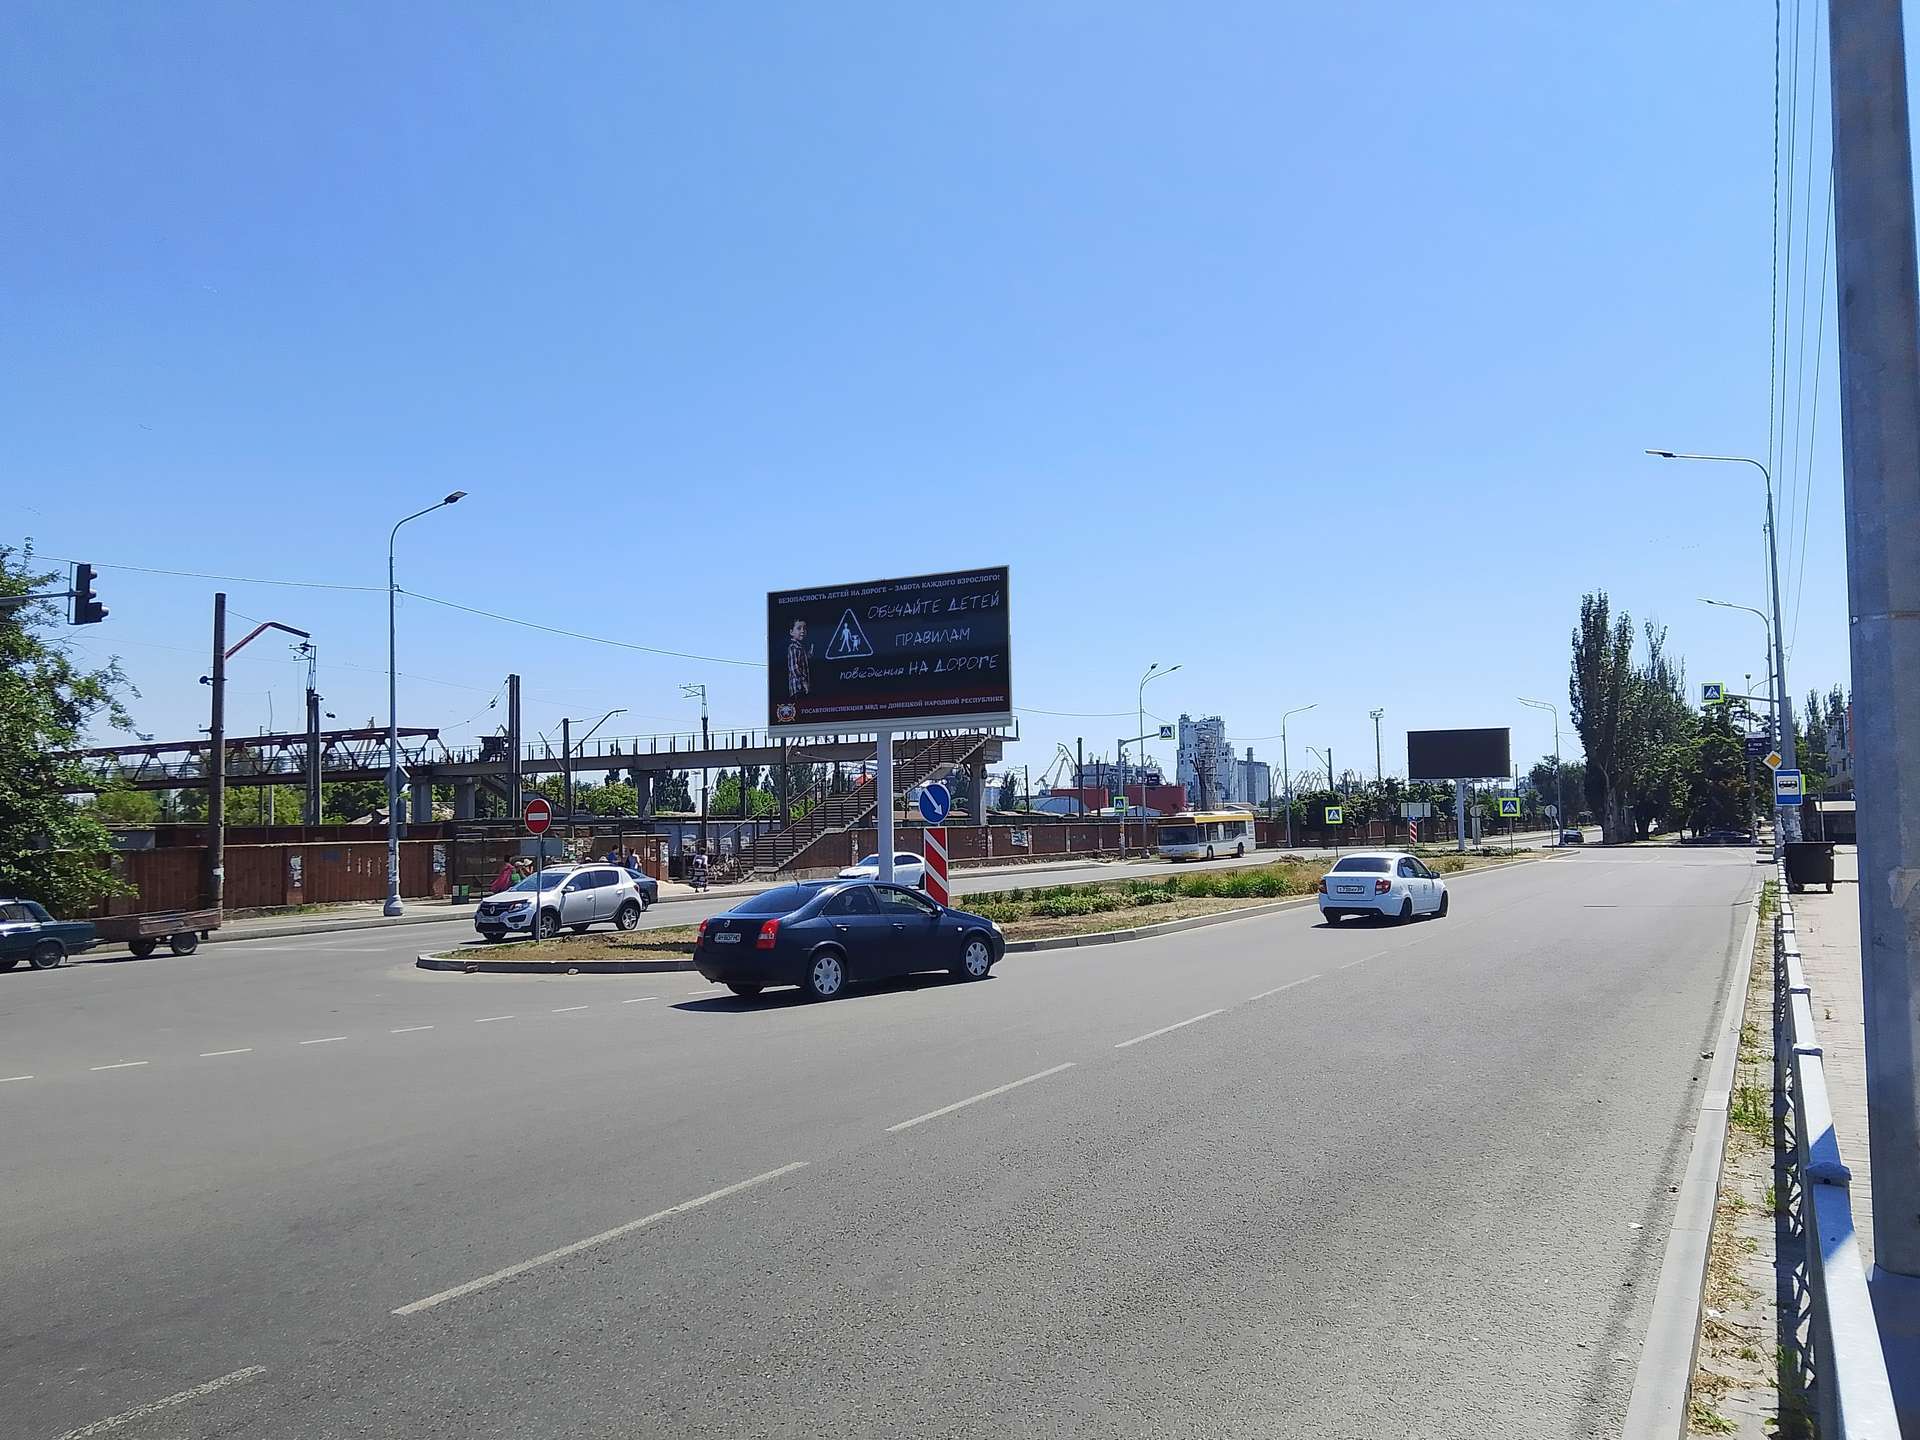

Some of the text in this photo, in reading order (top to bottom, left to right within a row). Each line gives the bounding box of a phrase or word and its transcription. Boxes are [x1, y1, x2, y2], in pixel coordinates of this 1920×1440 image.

[778, 594, 826, 604] БЕЗОПАСНОСТЬ
[827, 589, 849, 599] ДЕТЕЙ
[860, 586, 887, 596] ДОРОГЕ
[895, 583, 920, 592] ЗАБОТА
[921, 579, 956, 589] КАЖДОГО
[957, 574, 1000, 585] ВЗРОСЛОГО!
[868, 590, 1000, 619] ОБУЧАЙТЕ ДЕТЕЙ
[895, 627, 971, 647] ПРАВИЛАМ
[840, 654, 999, 680] поведения НА ДОРОГЕ
[801, 704, 864, 714] ГОСАВТОИНСПЕКЦИЯ
[864, 703, 879, 711] МВД
[887, 700, 923, 709] ДОНЕЦКОЙ
[924, 697, 960, 707] НАРОДНОЙ
[960, 695, 1004, 704] РЕСПУБЛИКЕ
